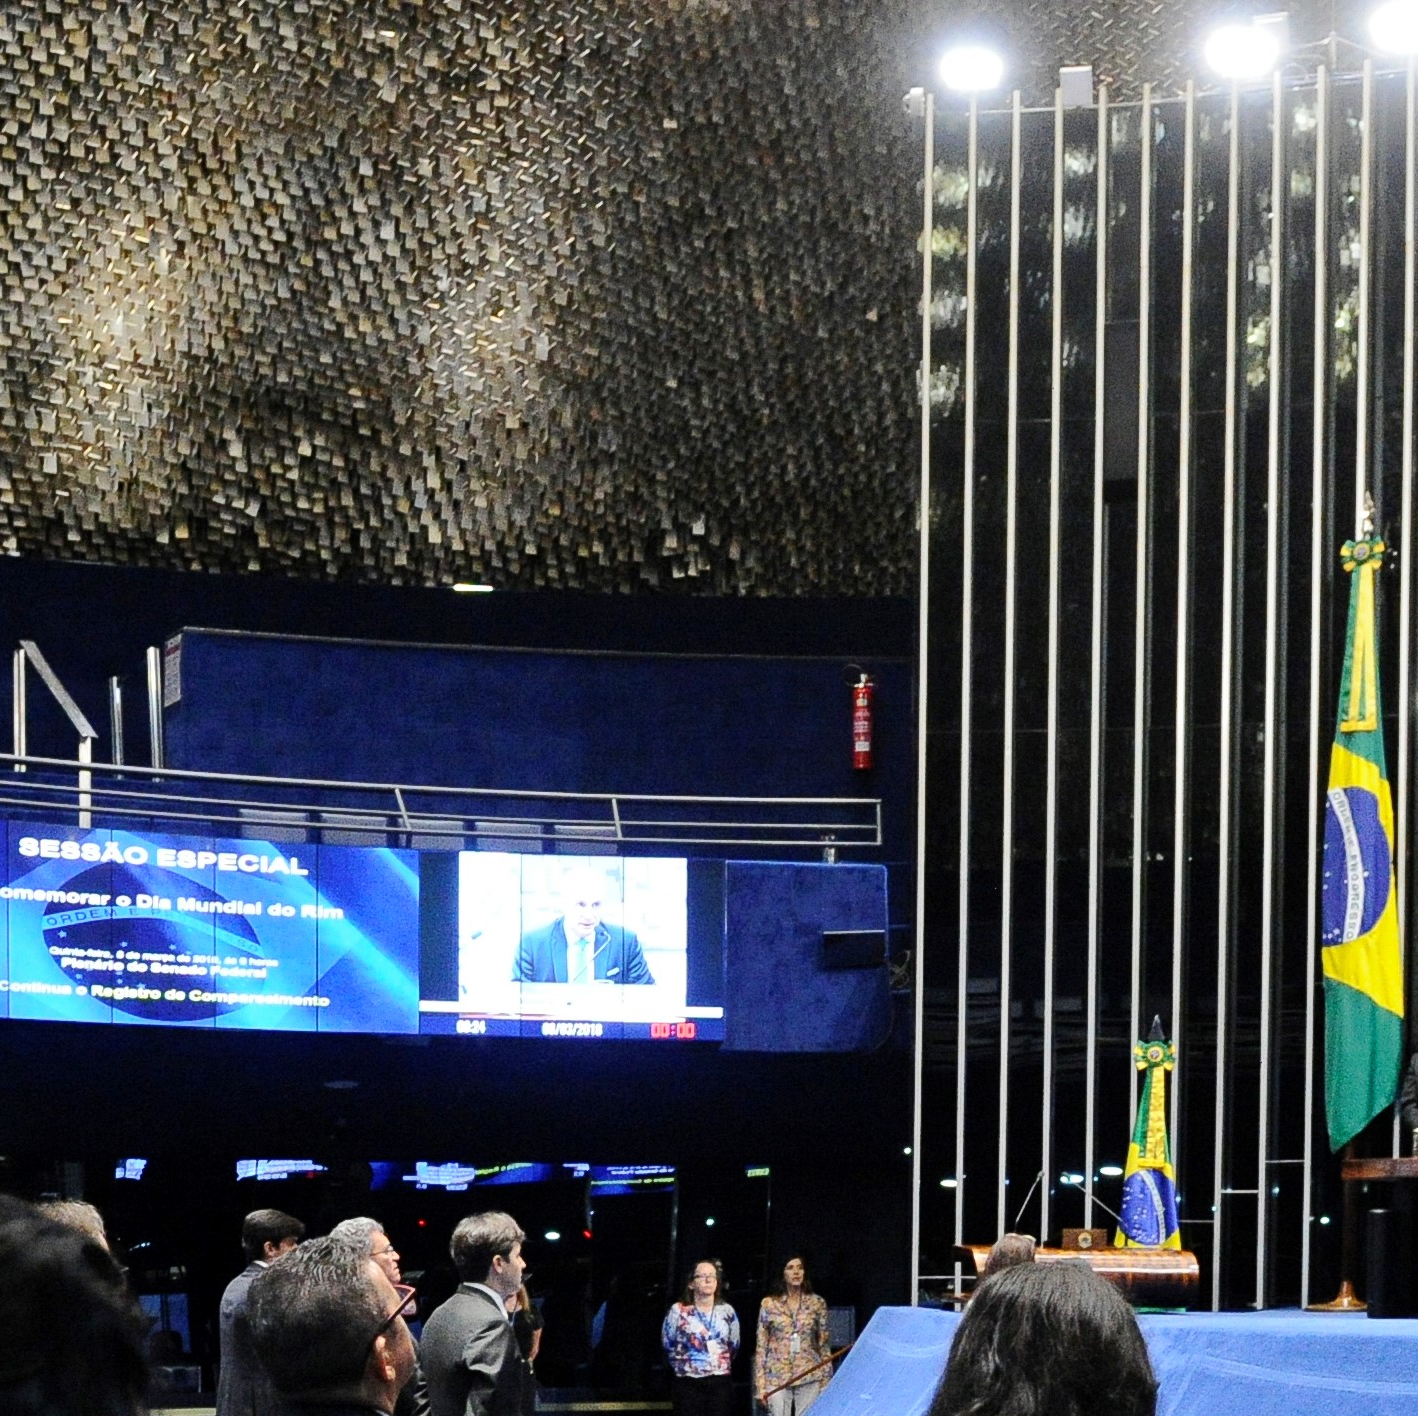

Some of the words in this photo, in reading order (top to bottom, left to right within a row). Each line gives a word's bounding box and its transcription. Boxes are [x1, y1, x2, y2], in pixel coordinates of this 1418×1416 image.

[19, 837, 148, 865] SESSÃO
[157, 849, 308, 876] ESPECIAL
[46, 908, 117, 926] ORDEM
[116, 895, 131, 907] o
[136, 894, 171, 910] Dia
[178, 897, 262, 916] Mundial
[267, 903, 296, 917] do
[301, 904, 343, 919] Rim
[126, 951, 141, 960] de
[61, 957, 125, 971] Plenário
[127, 961, 148, 972] do
[151, 962, 207, 976] Senado
[210, 965, 267, 978] Federal
[75, 985, 87, 996] o
[91, 985, 161, 1000] Registro
[165, 988, 185, 1001] de
[189, 989, 330, 1007] Comparecimento
[651, 1022, 696, 1039] 00:00
